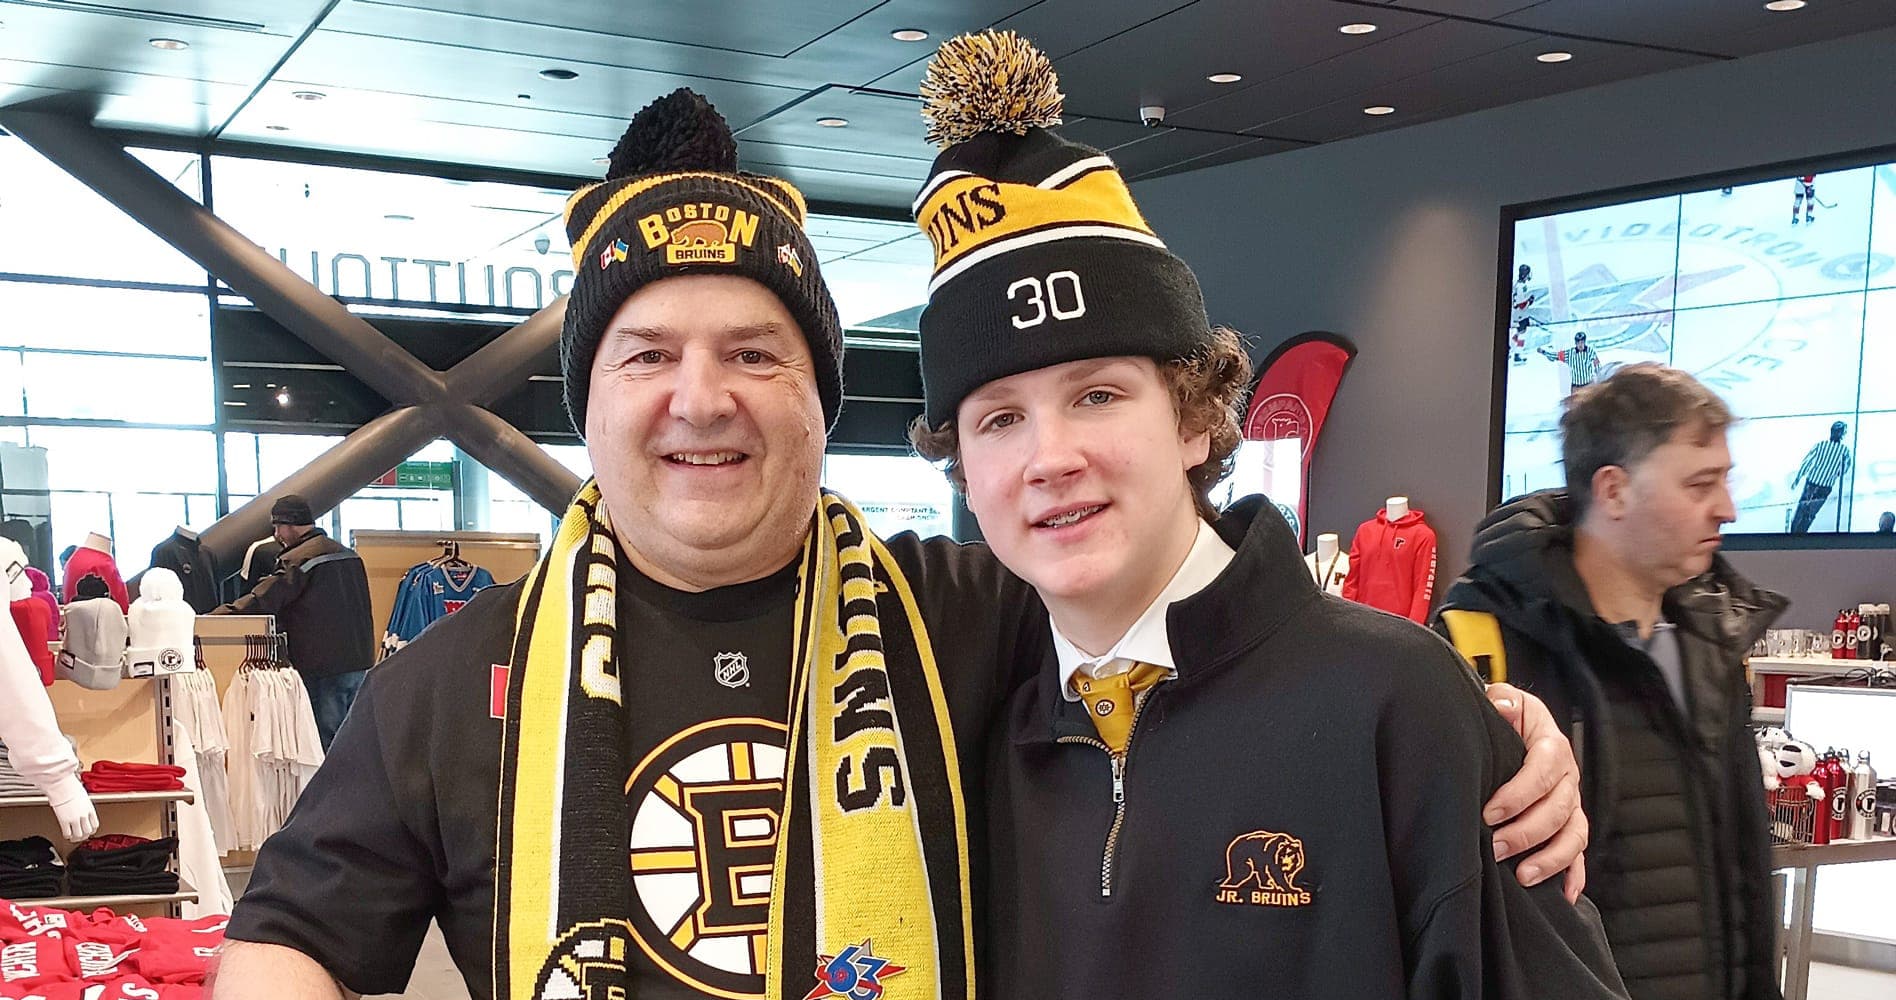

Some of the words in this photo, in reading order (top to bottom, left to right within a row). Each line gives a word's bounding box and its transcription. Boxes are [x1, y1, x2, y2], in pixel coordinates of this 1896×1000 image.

[638, 203, 759, 249] BOSTON
[675, 249, 726, 260] BRUINS
[1007, 271, 1086, 329] 30
[722, 660, 741, 681] NHL
[1216, 890, 1243, 903] JR.
[1251, 891, 1311, 906] BRUINS
